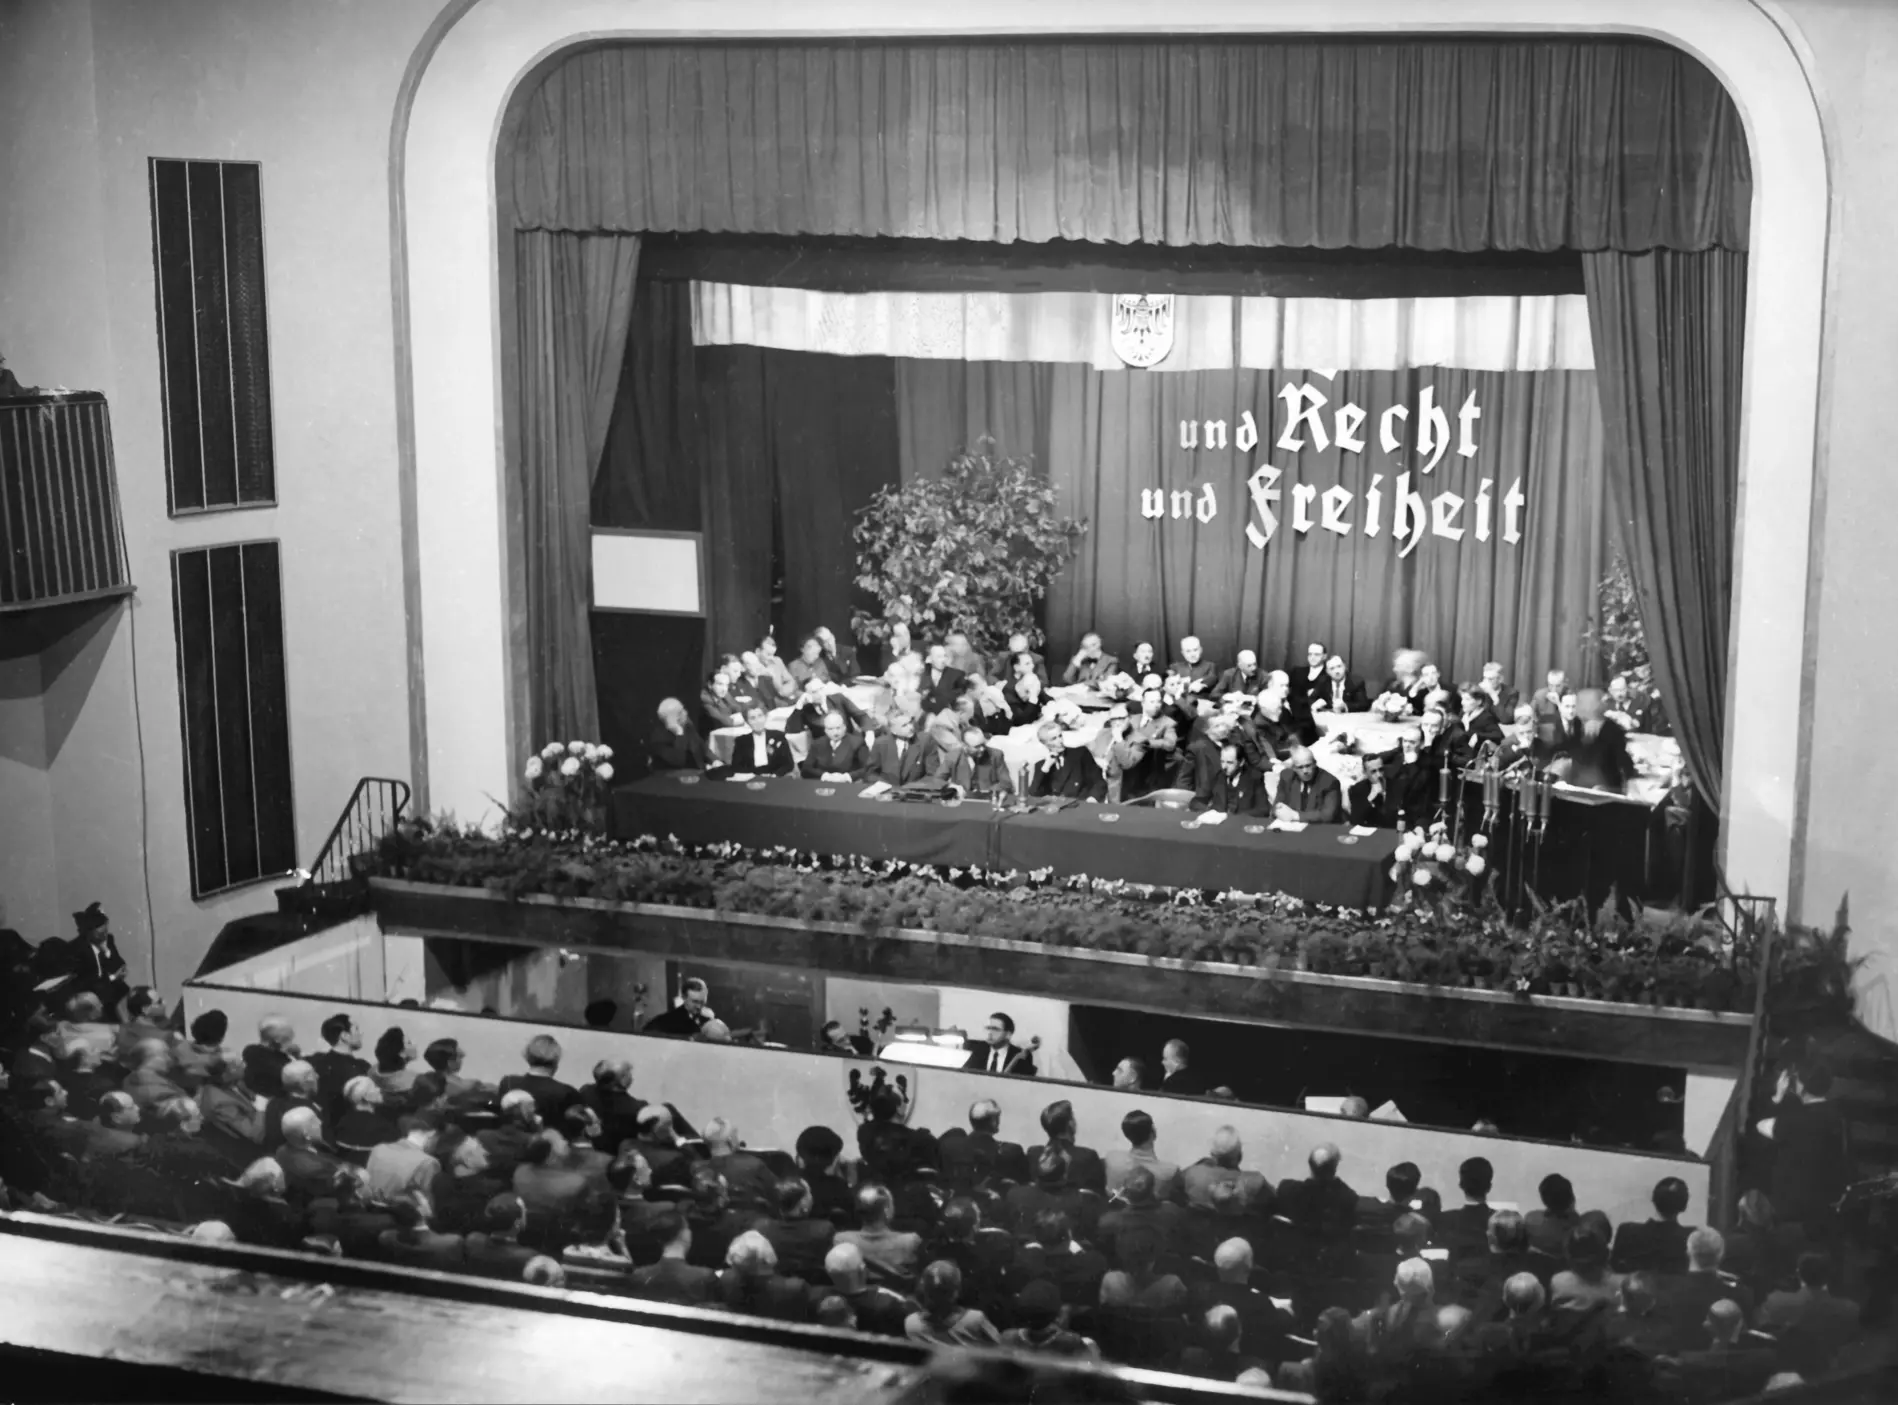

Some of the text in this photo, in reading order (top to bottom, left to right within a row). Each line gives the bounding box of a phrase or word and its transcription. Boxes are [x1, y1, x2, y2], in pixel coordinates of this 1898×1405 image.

[1179, 382, 1481, 474] und Recht
[1141, 464, 1525, 558] und Freiheit
